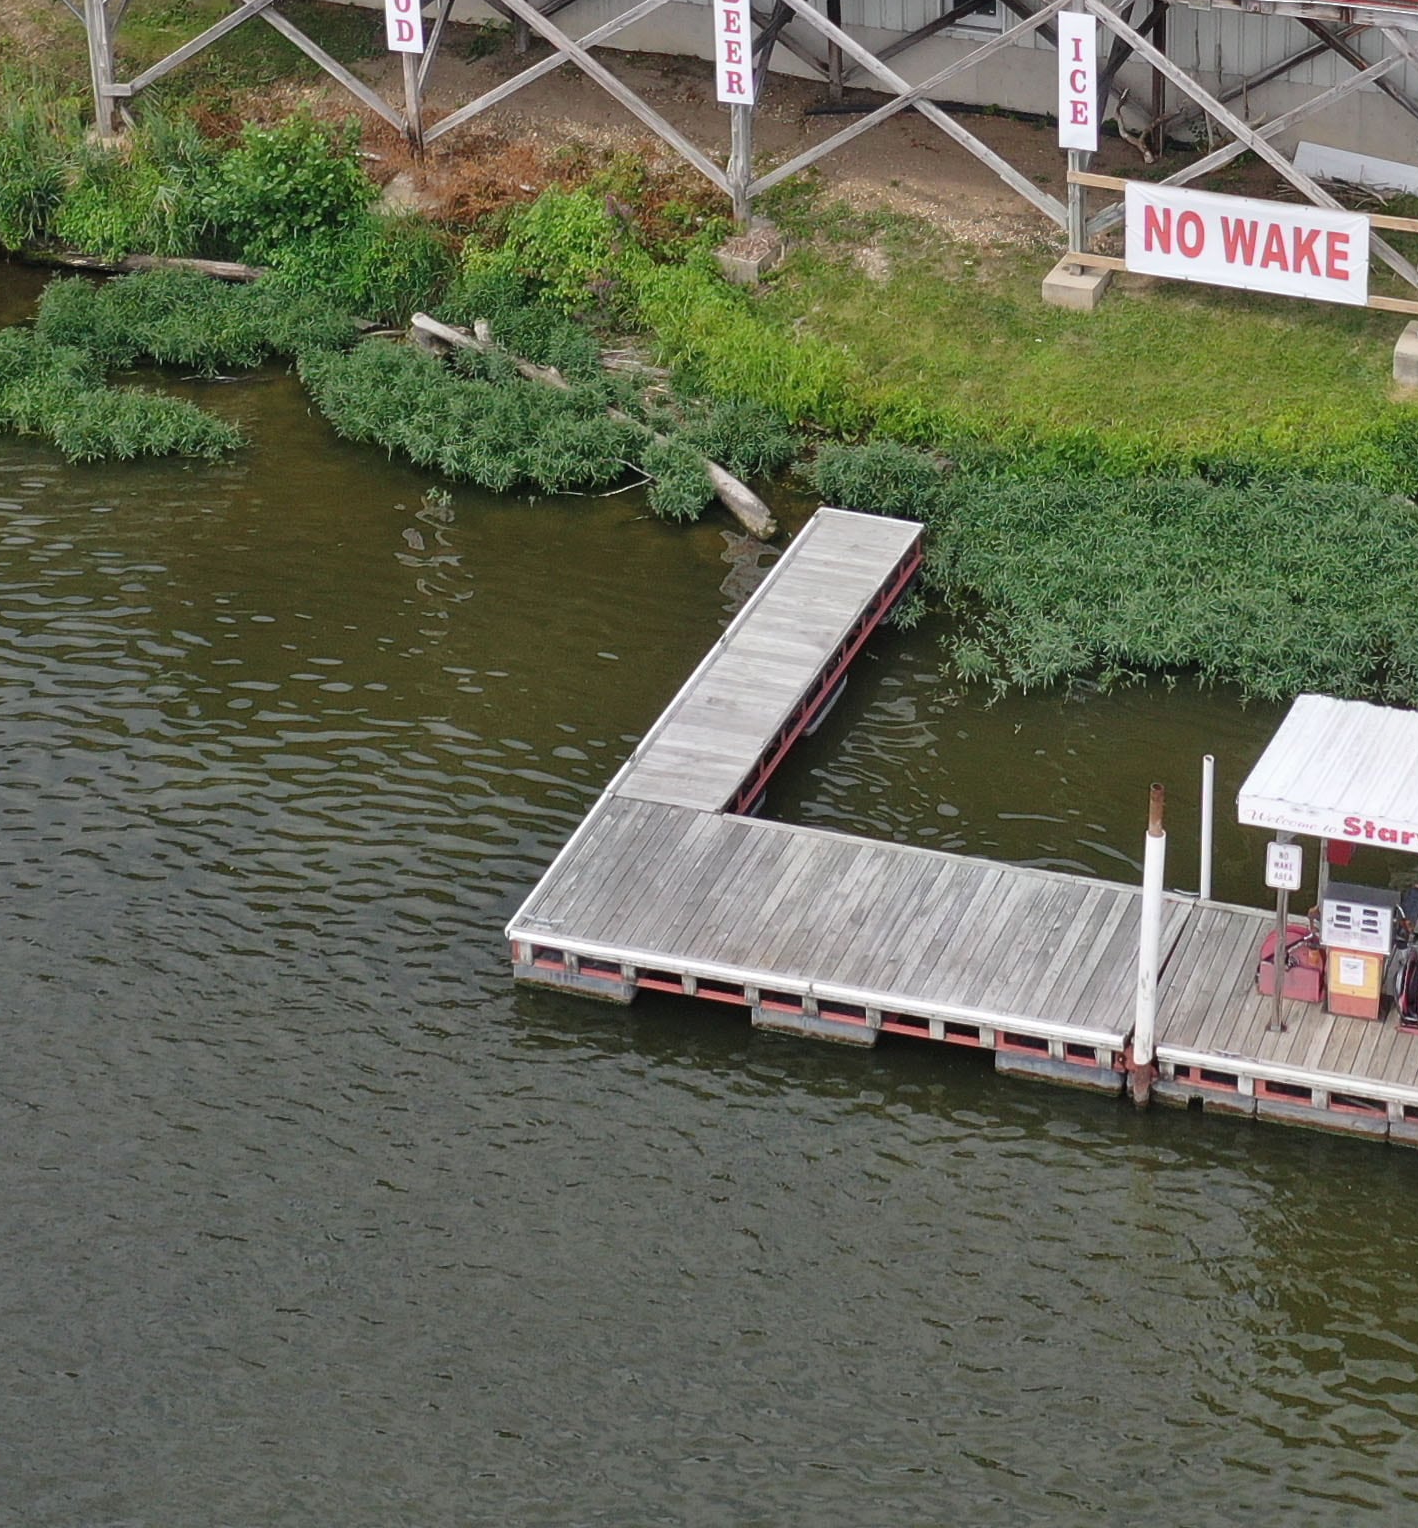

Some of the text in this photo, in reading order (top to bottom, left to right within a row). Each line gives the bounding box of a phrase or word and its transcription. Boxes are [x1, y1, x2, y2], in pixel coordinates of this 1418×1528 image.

[1069, 37, 1089, 126] ICE
[1144, 204, 1350, 281] NO WAKE
[1273, 861, 1293, 871] WAKE
[1278, 852, 1289, 861] NO
